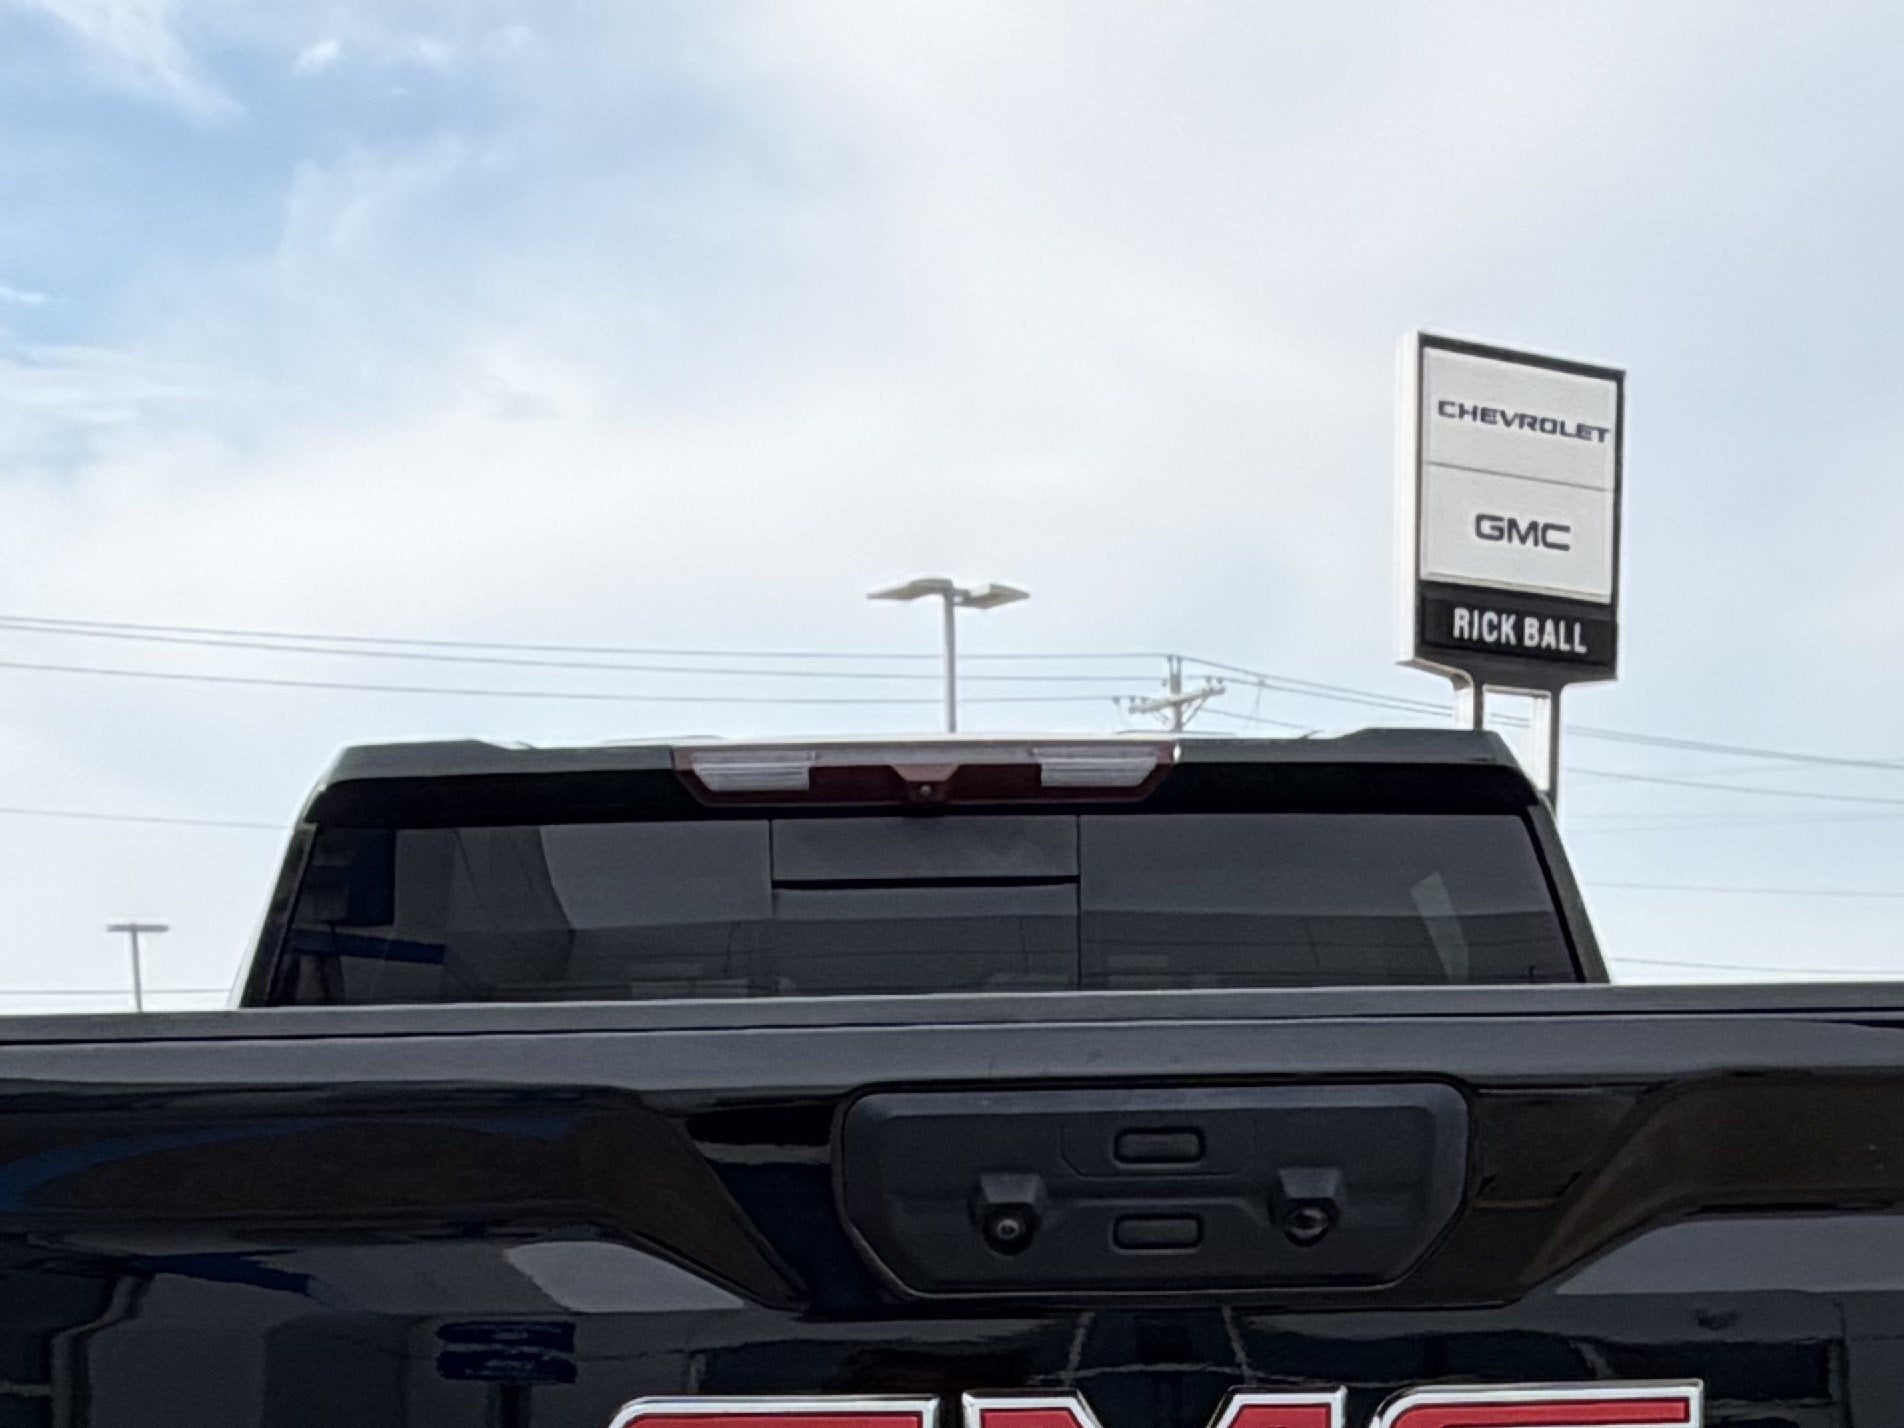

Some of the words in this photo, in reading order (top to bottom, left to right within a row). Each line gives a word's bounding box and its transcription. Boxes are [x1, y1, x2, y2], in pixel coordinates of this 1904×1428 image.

[1438, 399, 1610, 444] CHEVROLET
[1474, 513, 1572, 552] GMC
[1453, 607, 1518, 647] RICK
[1523, 617, 1588, 654] BALL
